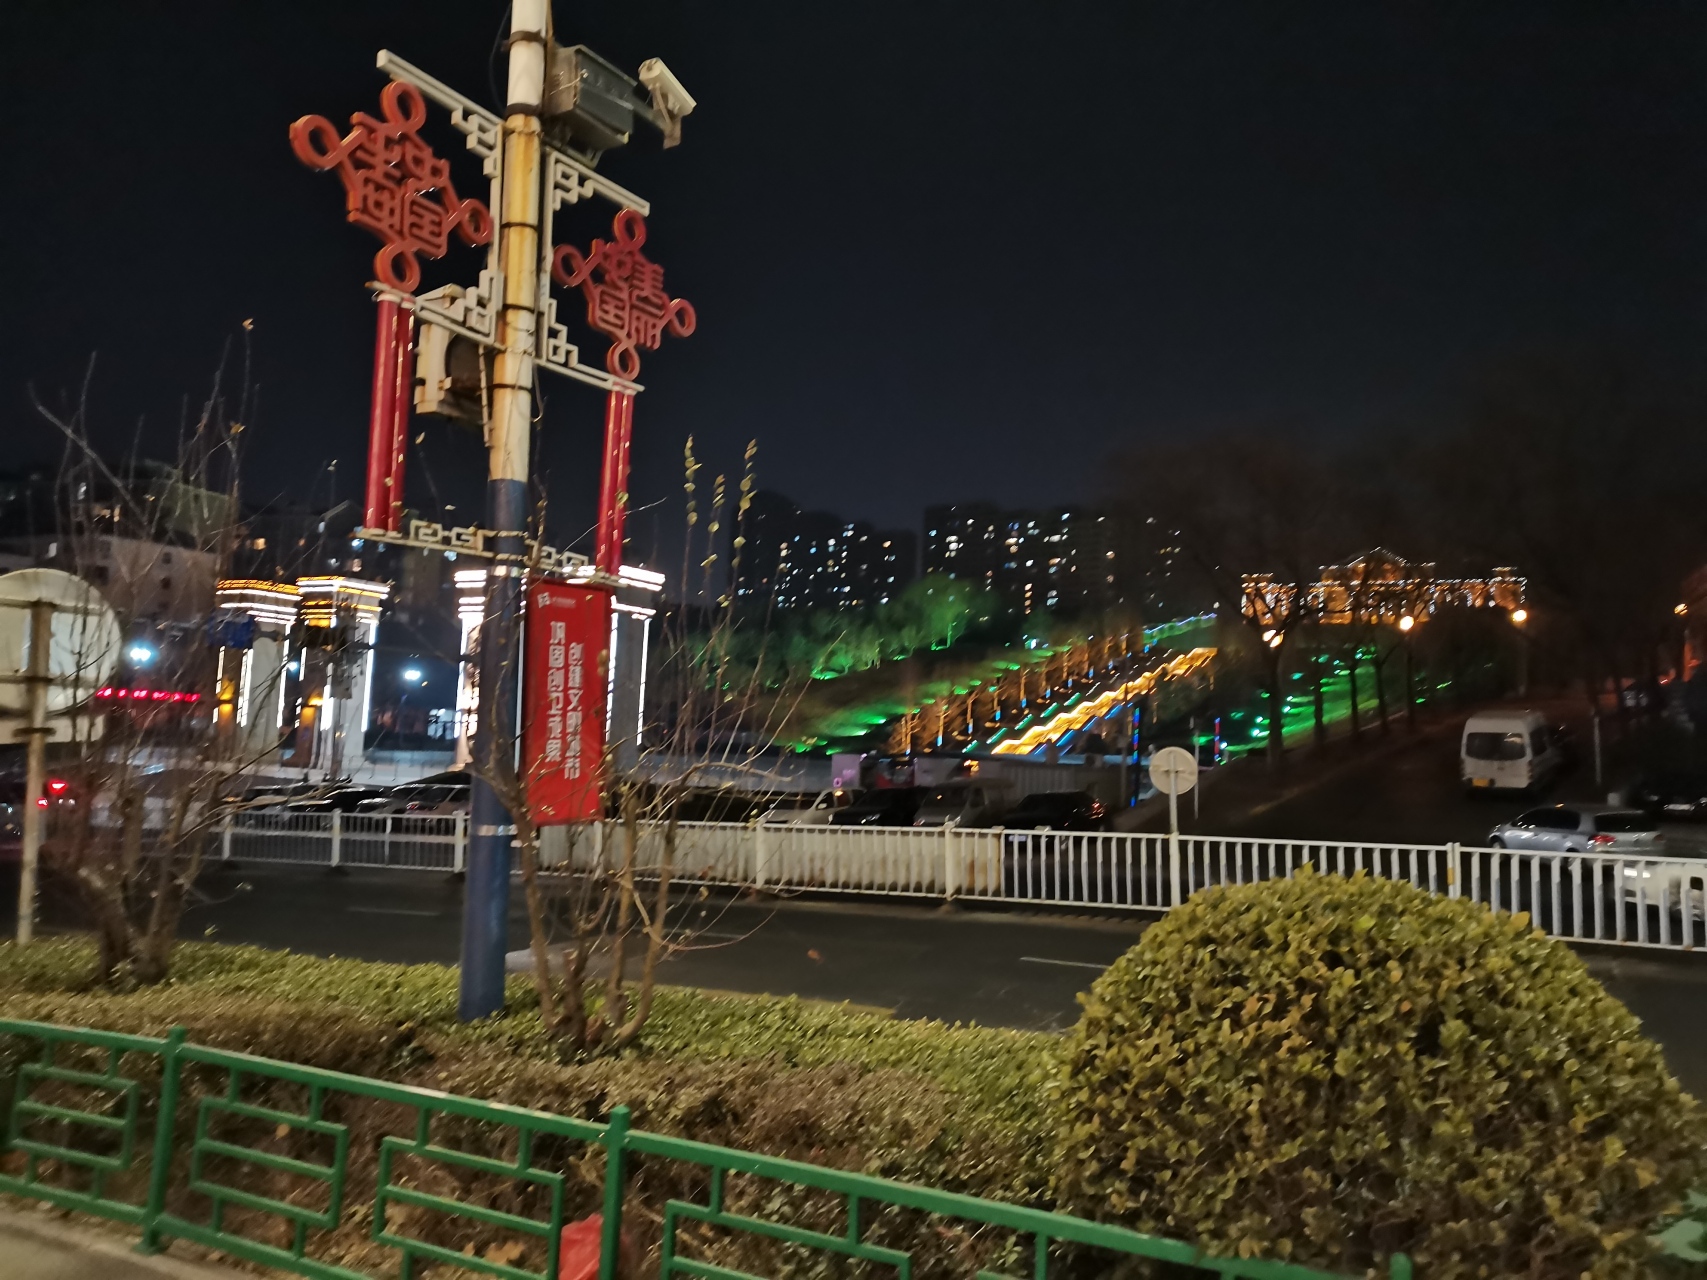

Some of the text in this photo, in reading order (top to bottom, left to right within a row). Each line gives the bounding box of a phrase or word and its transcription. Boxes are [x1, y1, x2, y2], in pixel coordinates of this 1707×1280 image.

[545, 621, 566, 763] 巩固创卫成果
[564, 642, 584, 780] 创建文明城市
